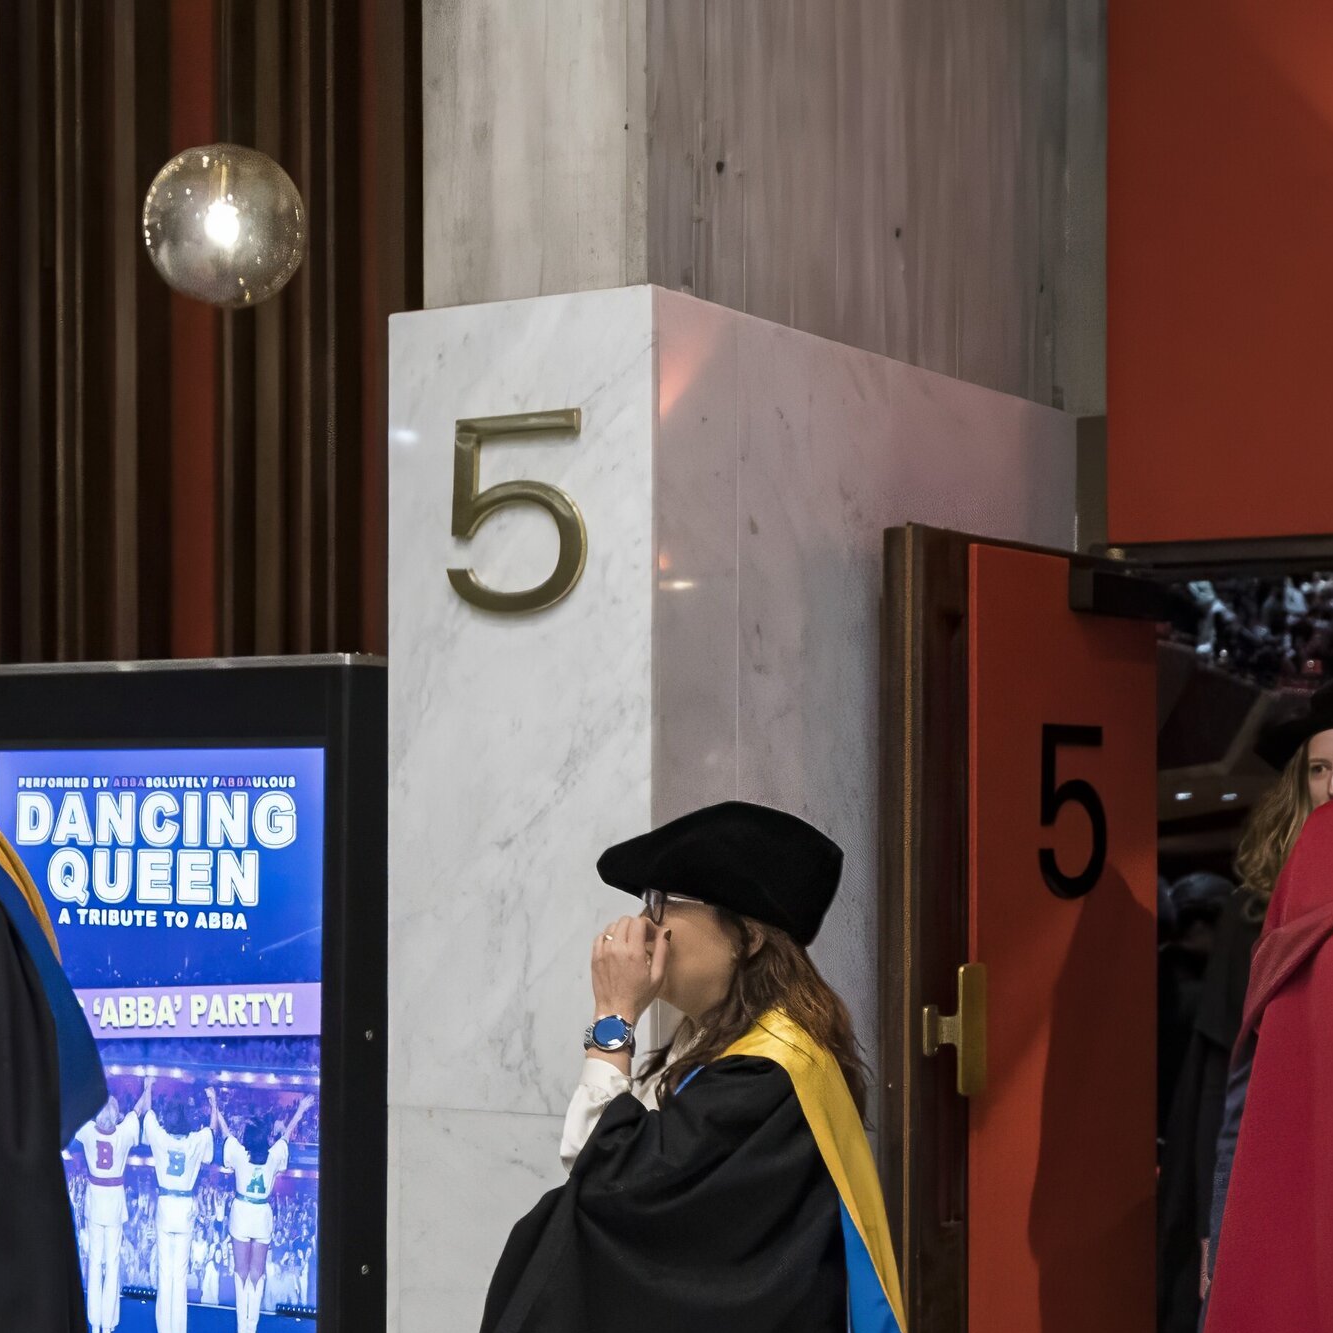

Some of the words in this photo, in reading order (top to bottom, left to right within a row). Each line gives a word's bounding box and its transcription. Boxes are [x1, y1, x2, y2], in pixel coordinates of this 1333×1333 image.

[447, 407, 588, 613] 5
[18, 776, 89, 788] PERFORMED
[93, 776, 109, 788] BY
[16, 791, 297, 849] DANCING
[1038, 723, 1107, 900] 5
[47, 846, 259, 907] QUEEN
[58, 908, 71, 924] A
[77, 908, 157, 927] TRIBUTE
[163, 911, 189, 928] TO
[195, 911, 248, 930] ABBA
[190, 993, 294, 1026] PARTY!
